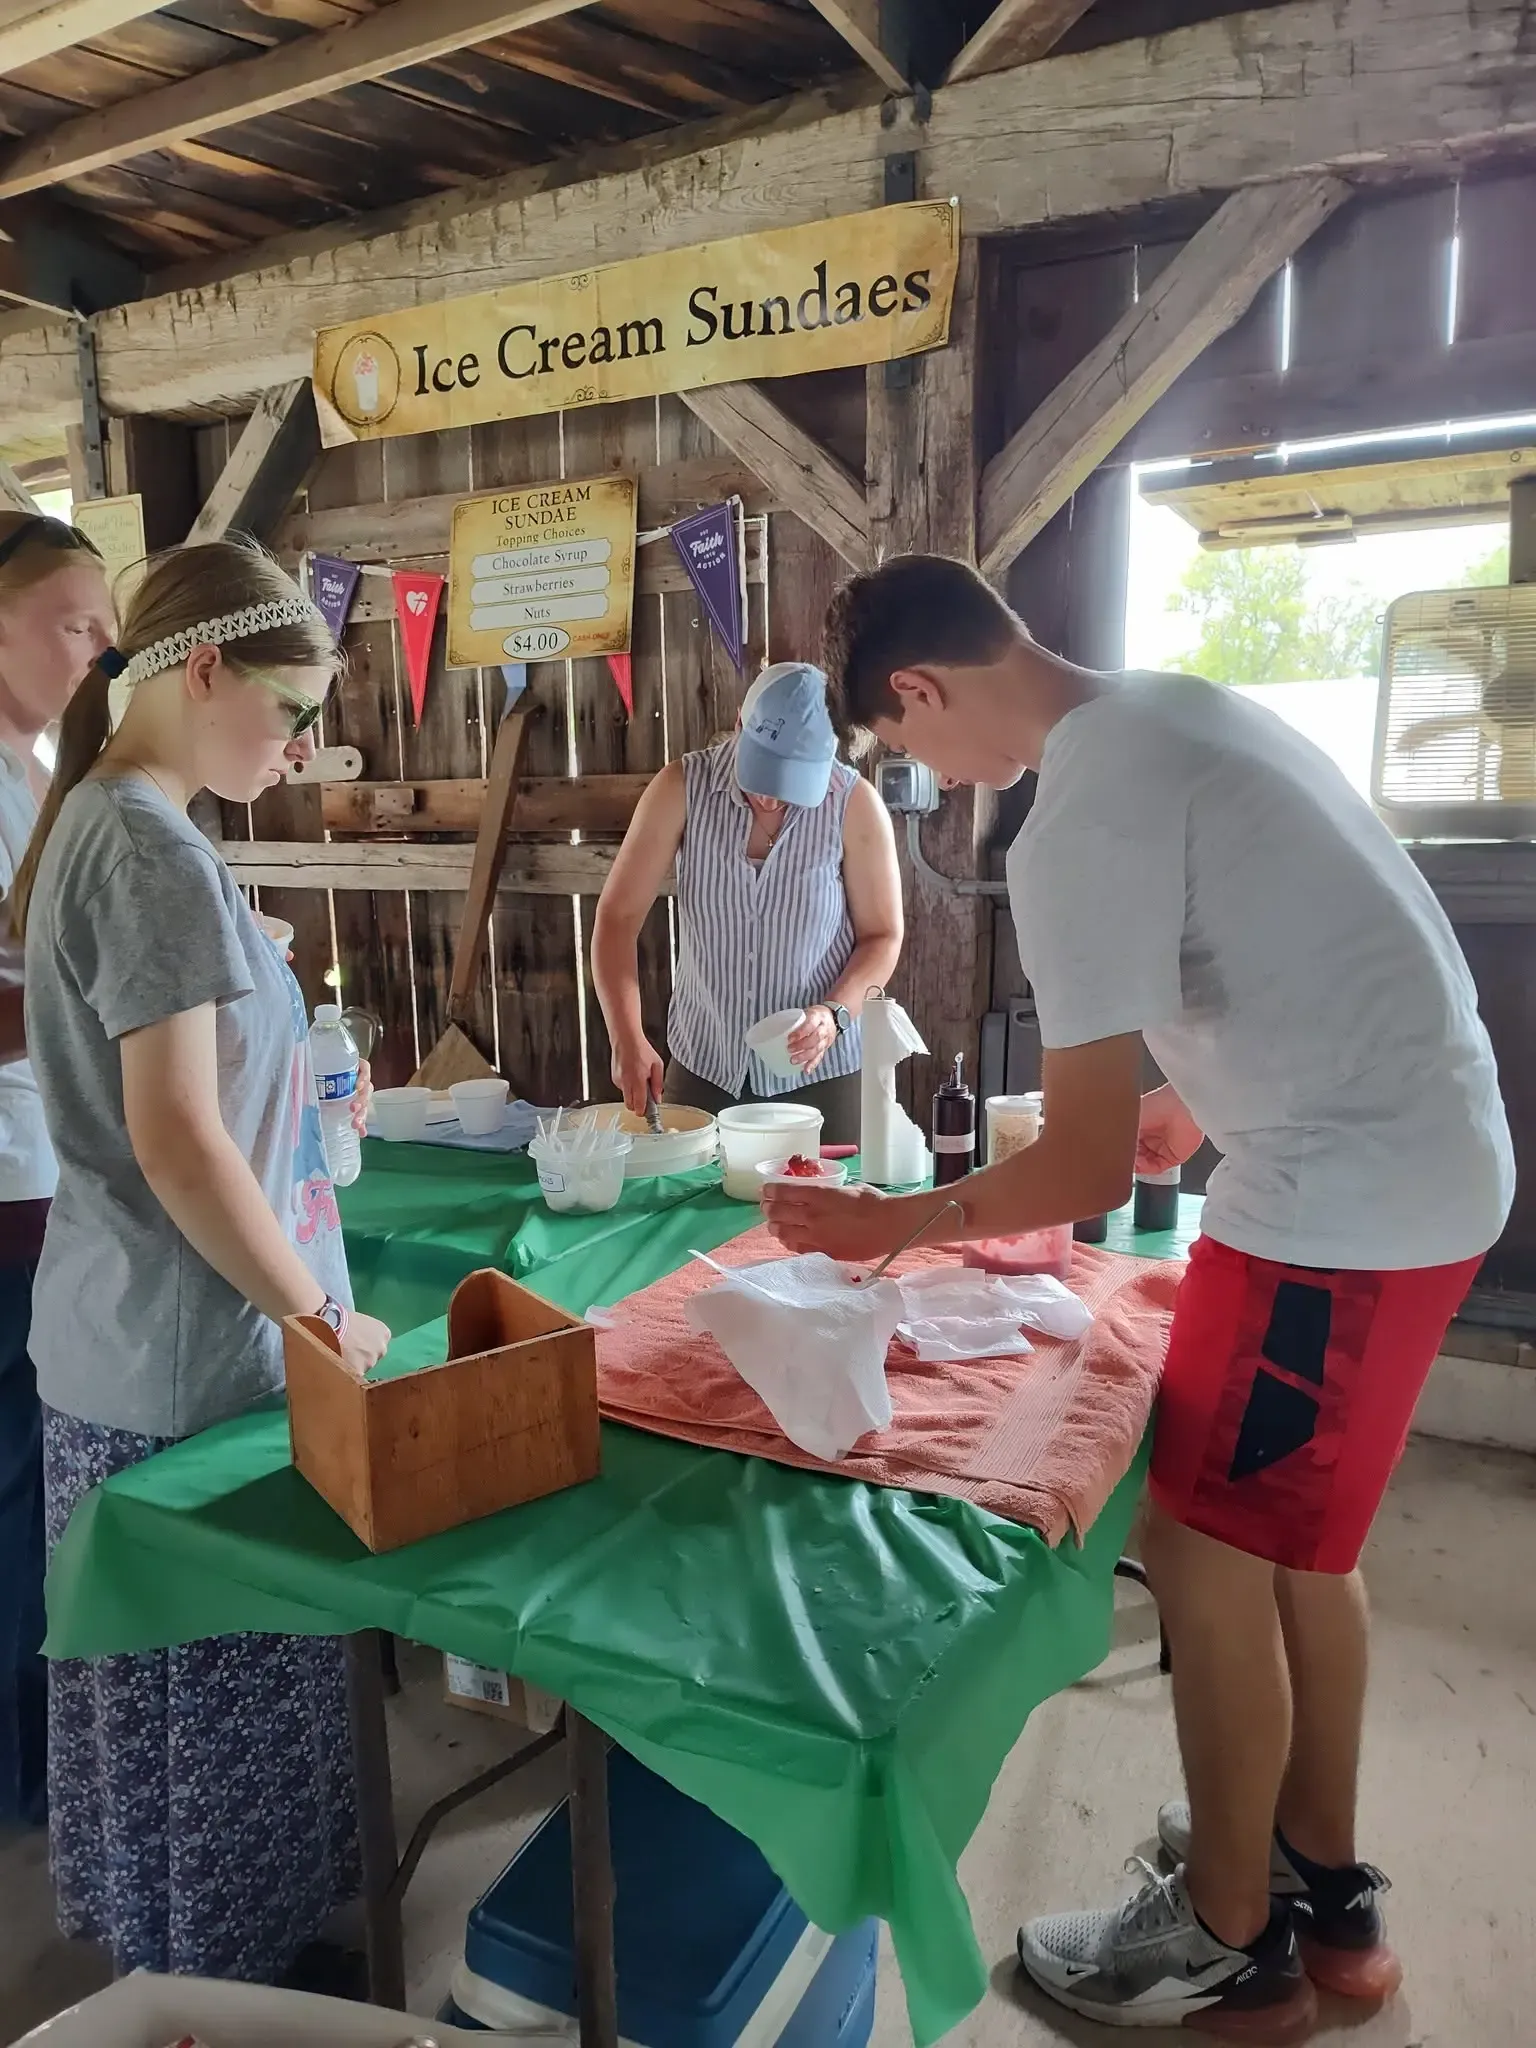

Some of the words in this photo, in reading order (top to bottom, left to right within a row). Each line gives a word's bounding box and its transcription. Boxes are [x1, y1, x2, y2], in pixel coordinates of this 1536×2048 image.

[413, 344, 481, 397] Ice
[498, 316, 666, 380] Cream
[686, 260, 933, 347] Sundaes
[492, 497, 520, 514] ICE
[527, 486, 592, 509] CREAM
[505, 507, 577, 530] SUNDAE
[496, 533, 540, 548] Topping
[543, 527, 586, 541] Choices
[689, 532, 724, 558] Faith
[492, 552, 550, 571] Chocolate
[554, 549, 588, 565] Syrup
[696, 552, 726, 569] ACTION
[503, 577, 575, 596] Strawberries
[524, 606, 551, 620] Nuts
[513, 632, 558, 652] $4.00
